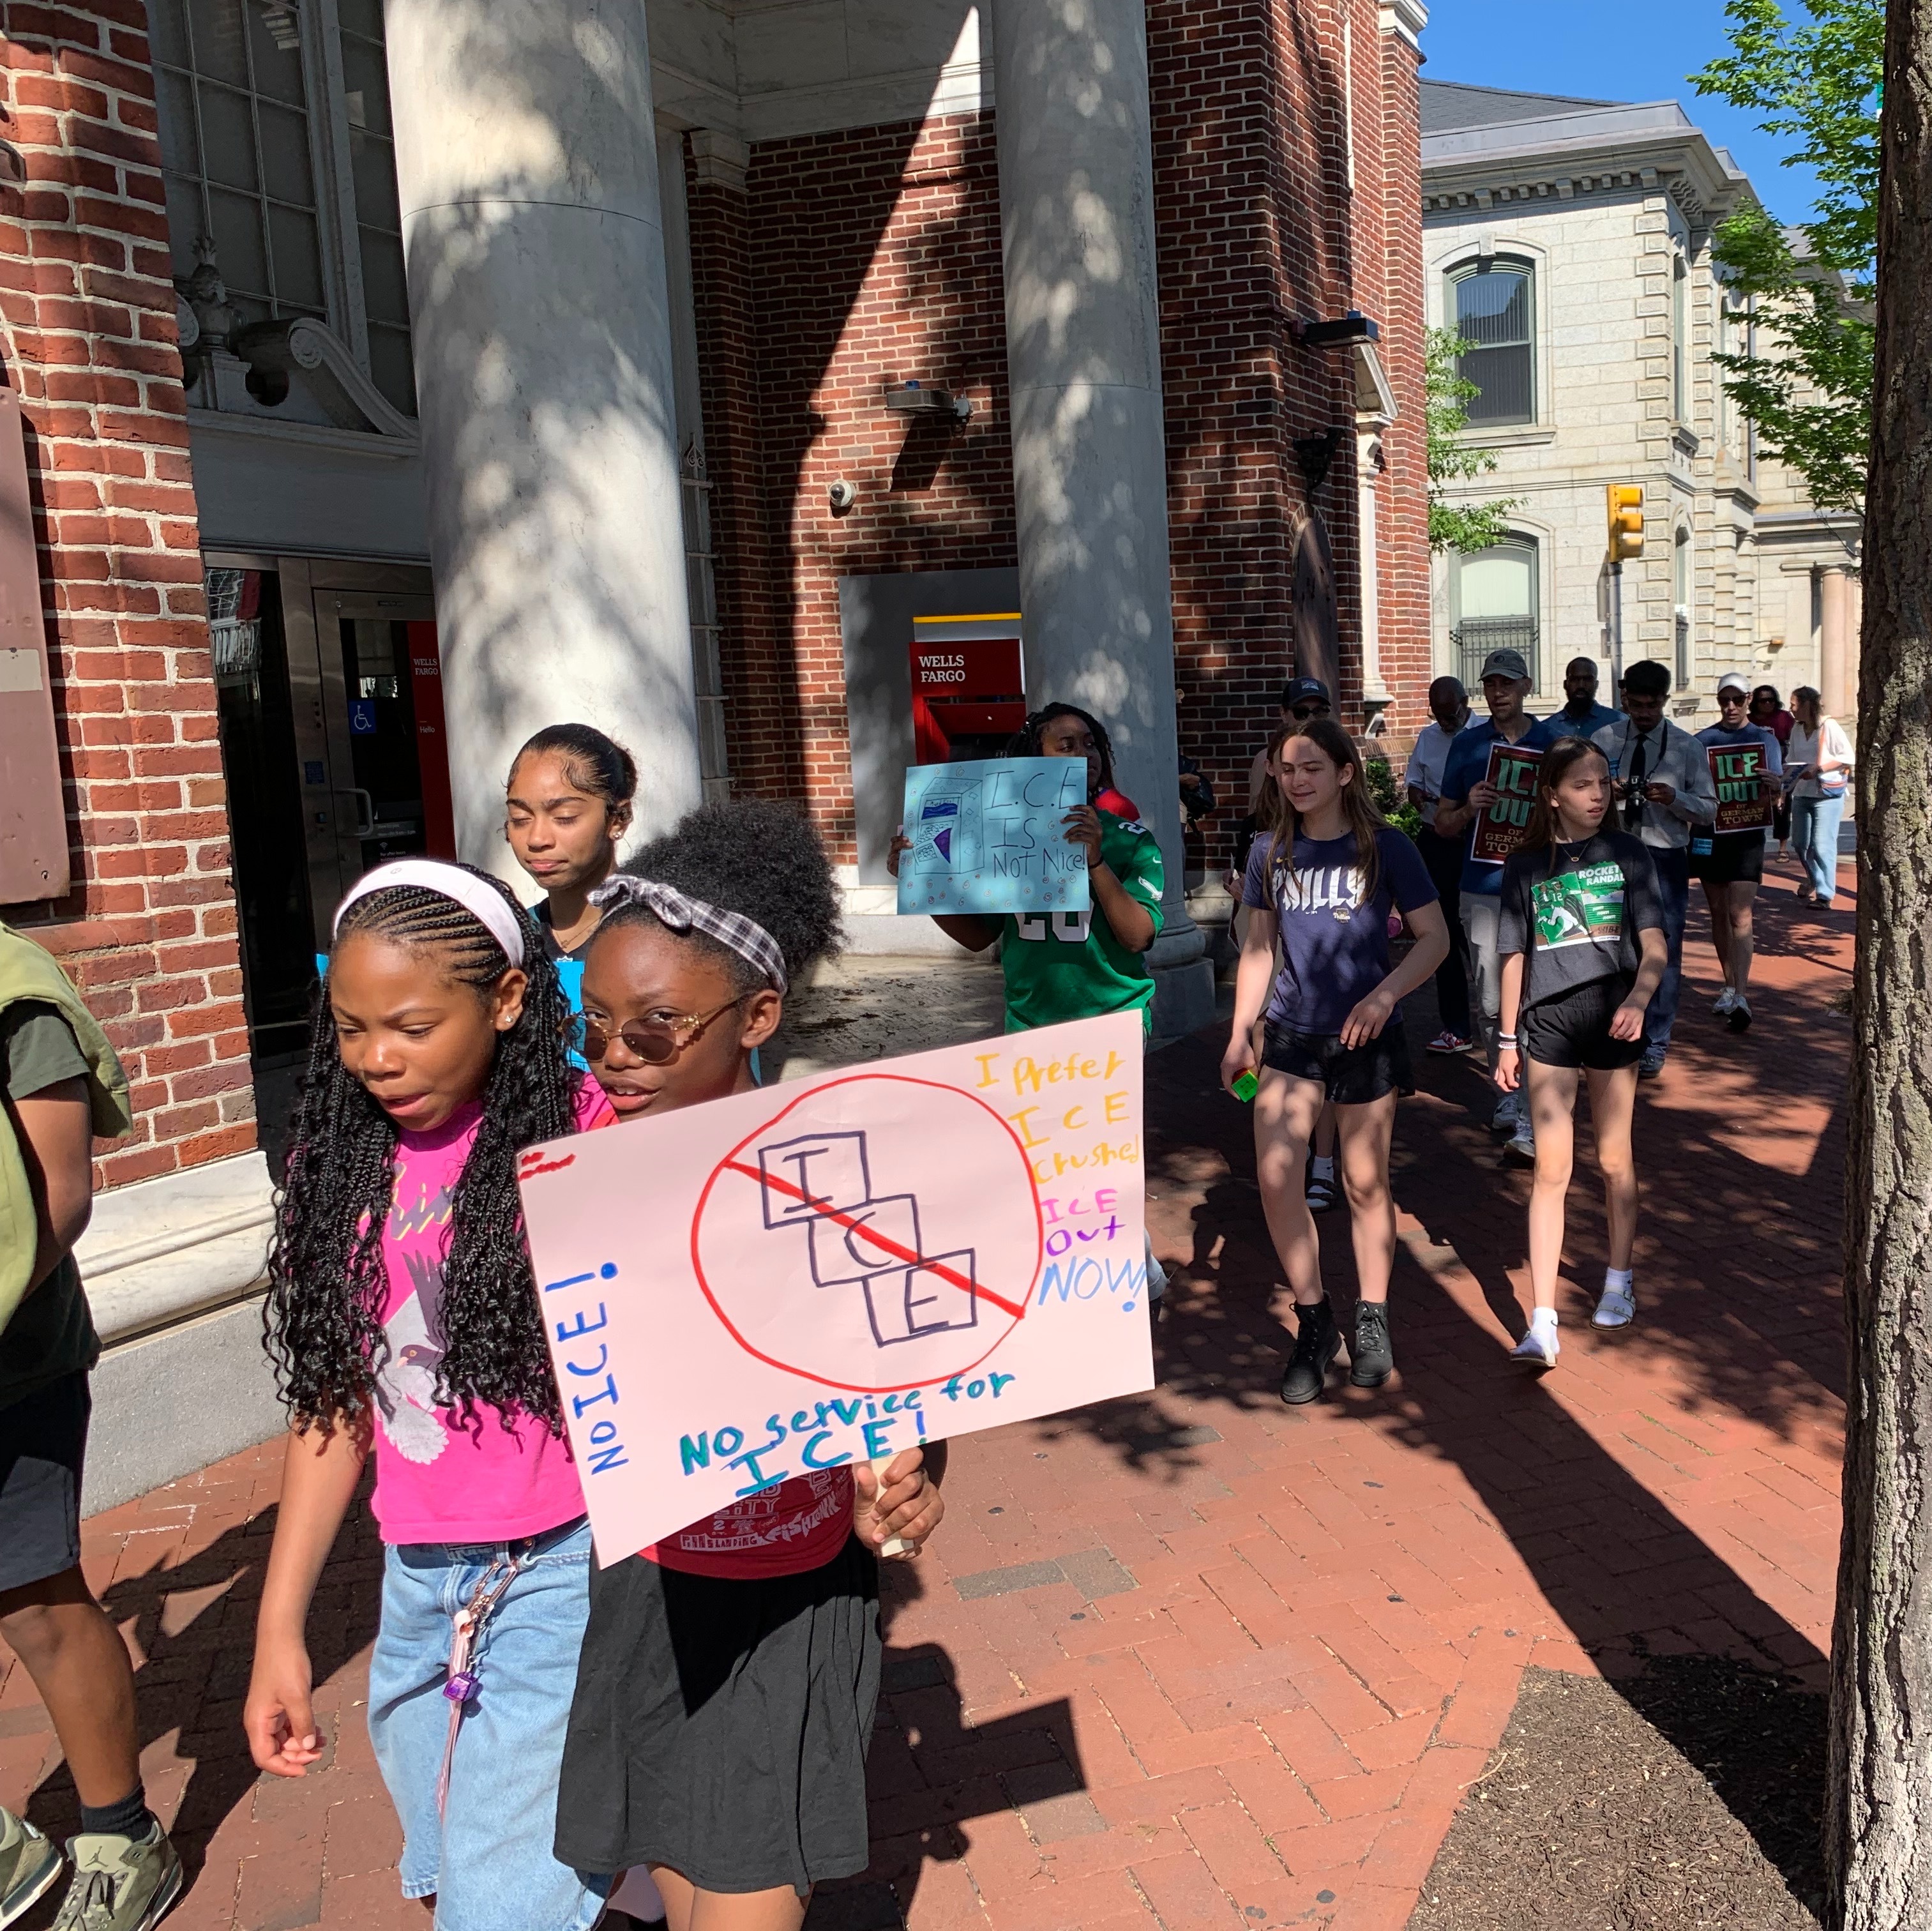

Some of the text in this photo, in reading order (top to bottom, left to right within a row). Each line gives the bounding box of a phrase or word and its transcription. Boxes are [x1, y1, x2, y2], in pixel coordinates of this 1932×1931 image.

[918, 655, 965, 667] WELLS
[920, 670, 965, 683] FARGO
[1716, 752, 1758, 780] ICE
[1717, 780, 1762, 803] OUT
[1489, 797, 1536, 827] OU
[1721, 807, 1765, 817] GERMAN
[1723, 814, 1763, 824] TOWN
[989, 817, 1038, 849] IS
[1485, 833, 1525, 844] GERM
[1578, 865, 1620, 879] ROCKET
[974, 1053, 1000, 1087] I
[1041, 1188, 1119, 1224] ICE
[766, 1390, 923, 1445] service
[939, 1372, 1016, 1402] for
